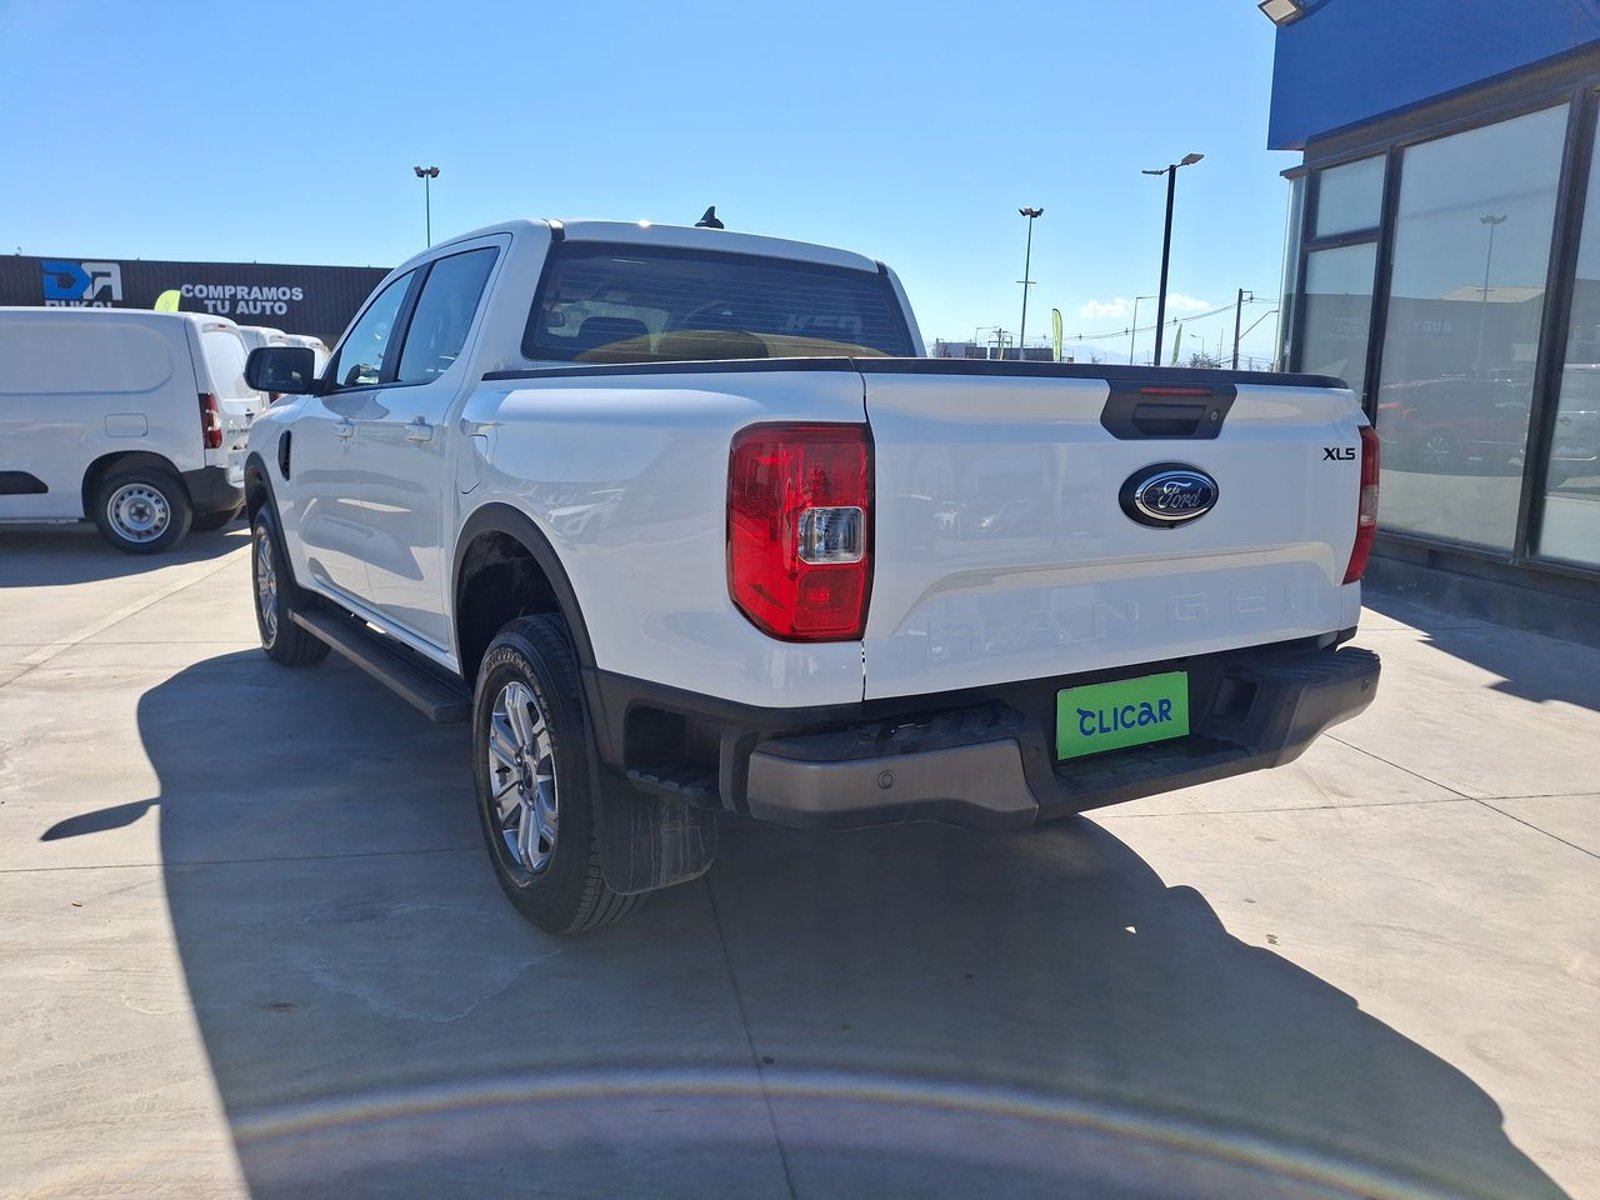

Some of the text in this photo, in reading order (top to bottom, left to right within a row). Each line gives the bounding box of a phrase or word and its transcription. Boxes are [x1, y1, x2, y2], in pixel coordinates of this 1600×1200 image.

[180, 284, 304, 301] COMPRAMOS
[203, 299, 288, 315] TU AUTO
[1323, 447, 1356, 461] XLS
[1157, 480, 1203, 509] Ford
